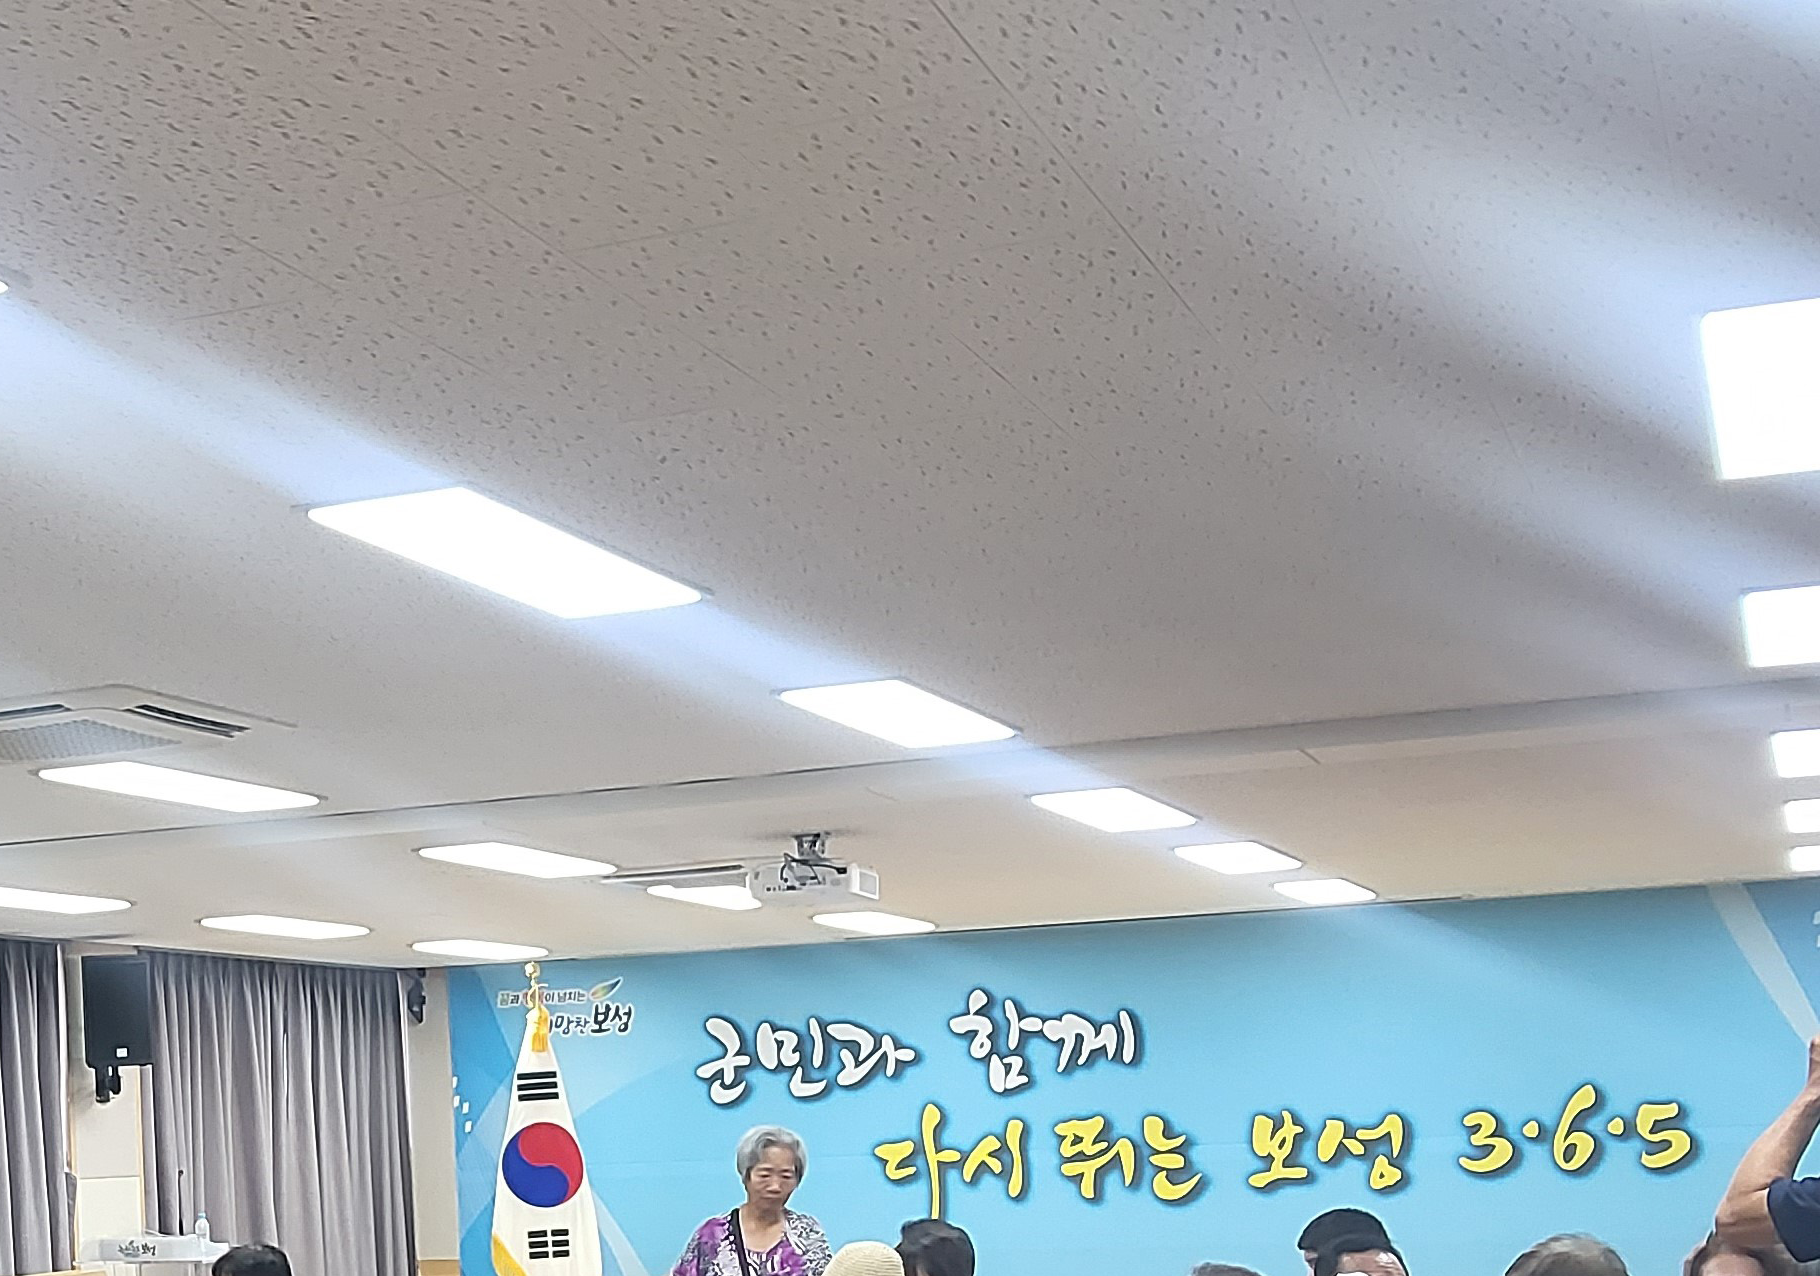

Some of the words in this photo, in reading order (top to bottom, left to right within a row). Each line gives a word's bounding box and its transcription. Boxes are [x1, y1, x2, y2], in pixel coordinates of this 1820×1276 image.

[548, 1014, 590, 1035] 망찬
[590, 1003, 632, 1034] 보성
[695, 1017, 917, 1105] 군민과
[949, 989, 1137, 1094] 함께
[874, 1103, 1025, 1219] 다시
[1054, 1115, 1202, 1201] 뛰는
[1247, 1109, 1405, 1190] 보성
